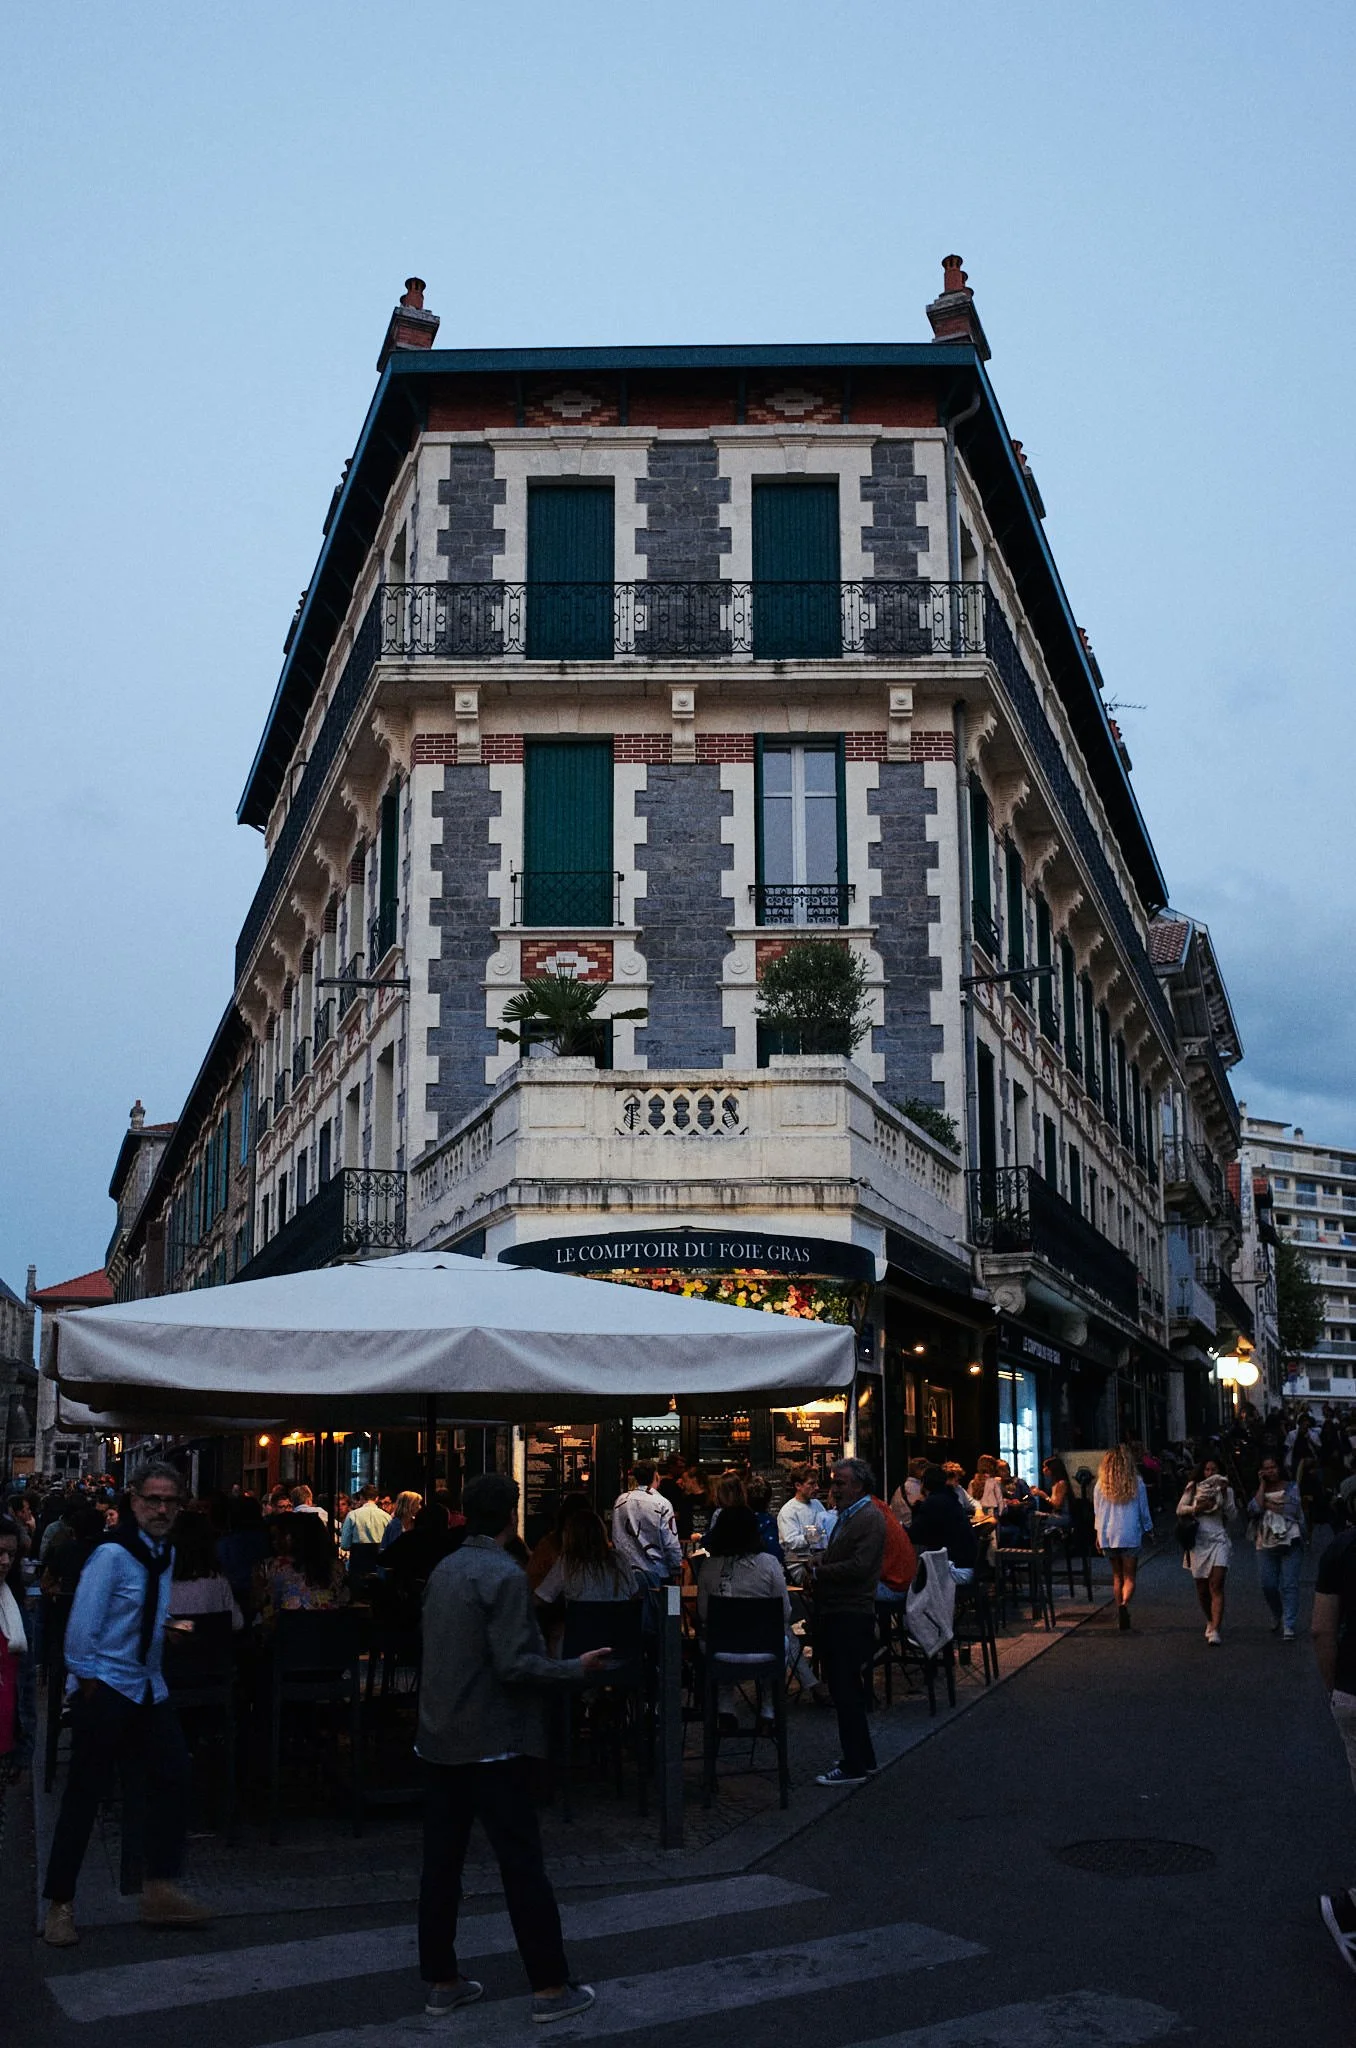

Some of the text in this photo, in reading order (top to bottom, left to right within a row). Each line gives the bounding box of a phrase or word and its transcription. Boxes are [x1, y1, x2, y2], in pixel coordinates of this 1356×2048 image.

[556, 1242, 811, 1264] LE COMPTOIR DU FOIE GRAS
